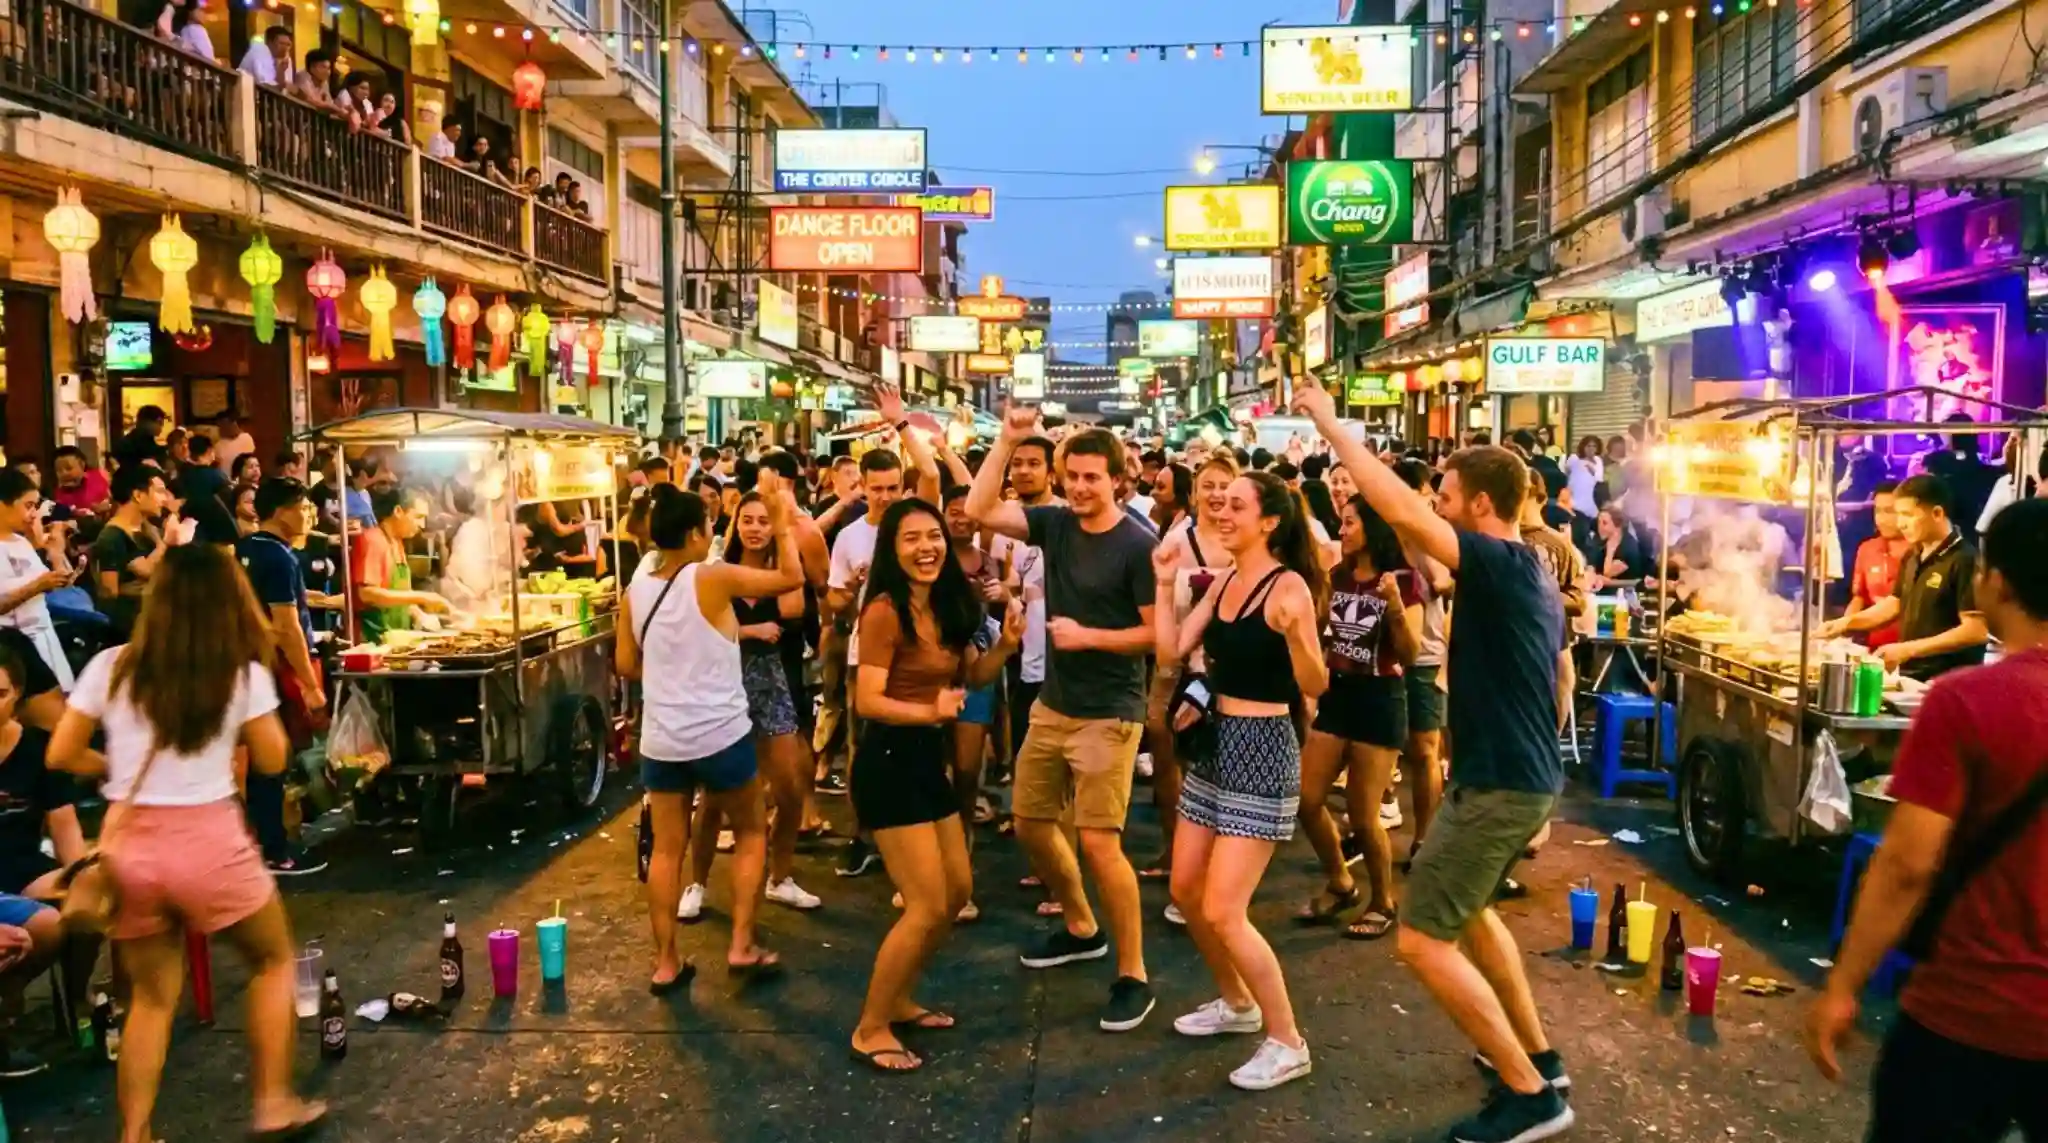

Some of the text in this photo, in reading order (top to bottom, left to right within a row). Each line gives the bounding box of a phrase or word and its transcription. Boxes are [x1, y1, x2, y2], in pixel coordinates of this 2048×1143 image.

[780, 172, 809, 187] THE
[813, 172, 868, 187] CENTER
[1311, 197, 1388, 224] Chang
[775, 214, 917, 236] DANCE FLOOR
[817, 242, 874, 265] OPEN
[1492, 345, 1600, 364] GULF BAR
